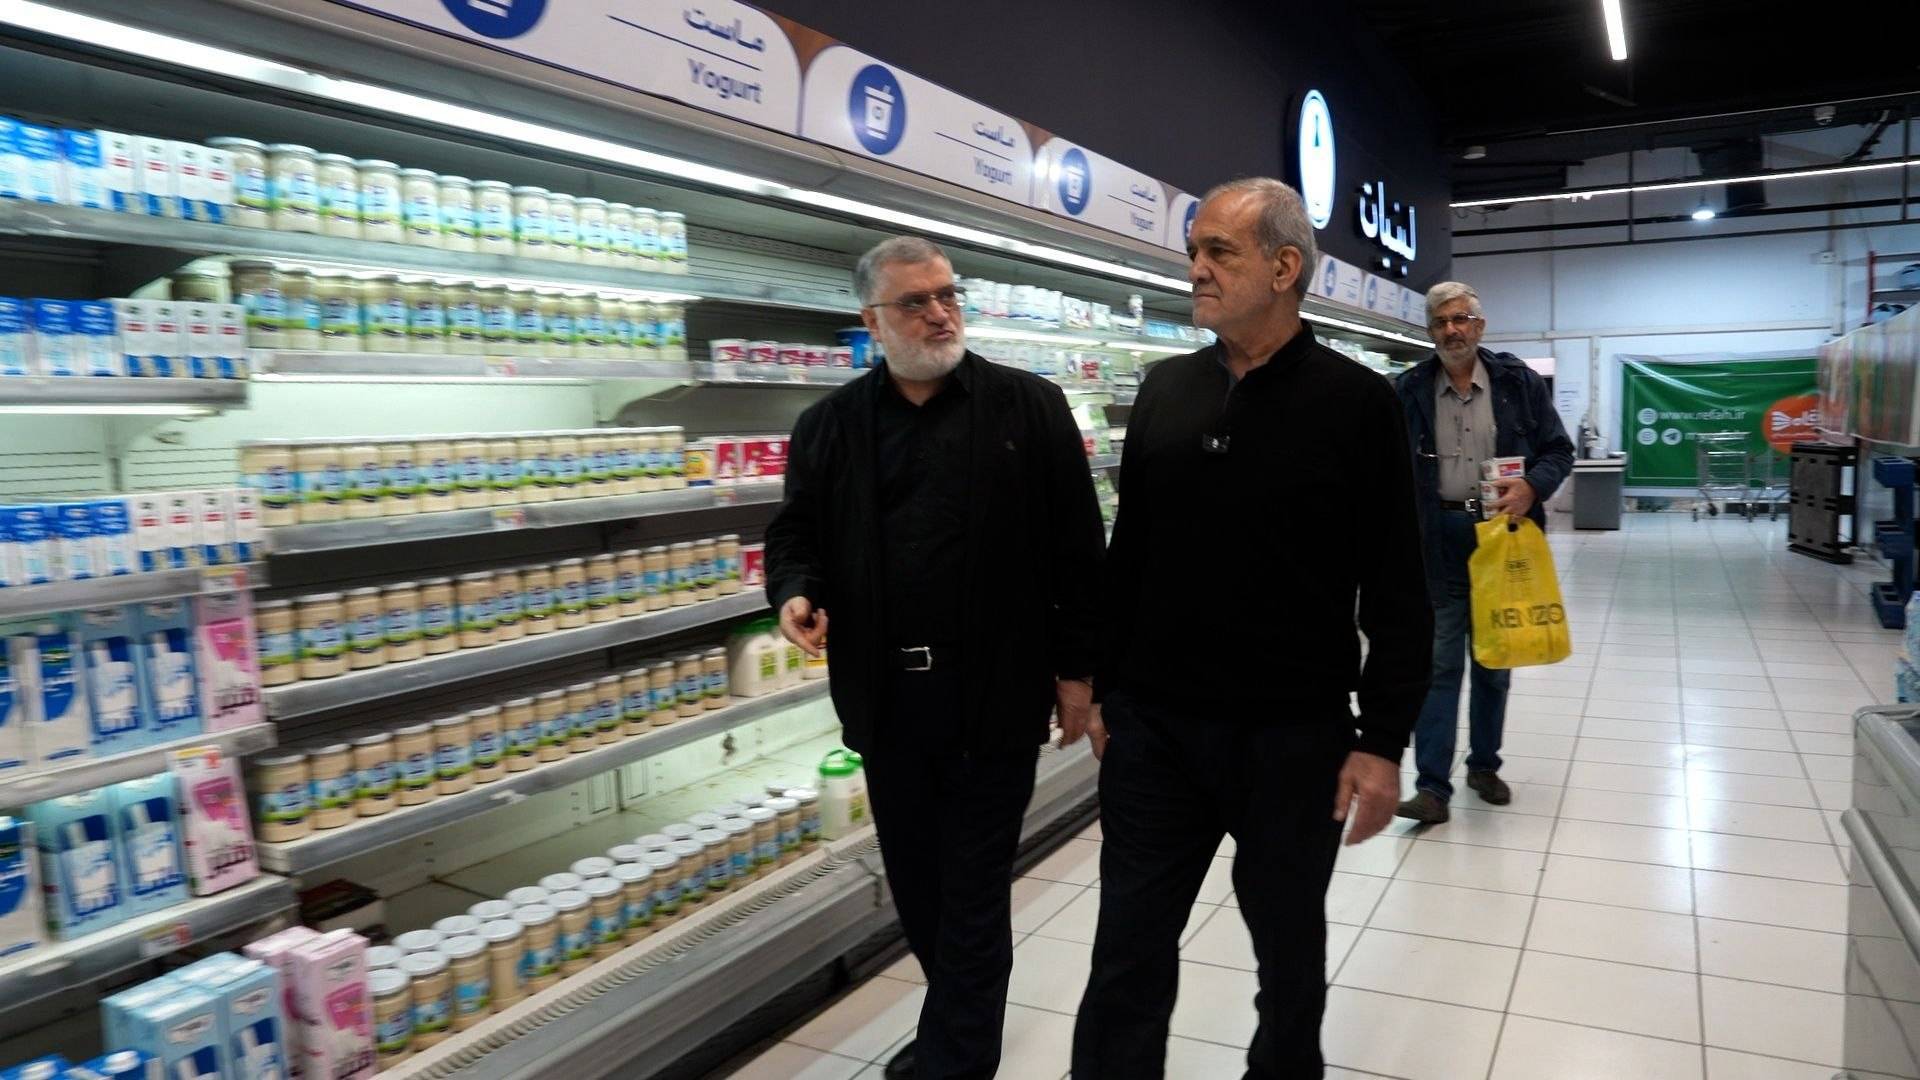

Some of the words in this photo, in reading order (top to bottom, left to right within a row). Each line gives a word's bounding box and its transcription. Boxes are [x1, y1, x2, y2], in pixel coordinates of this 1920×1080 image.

[681, 8, 766, 52] ماست
[688, 58, 762, 104] Yogurt
[972, 121, 1016, 148] ماست
[974, 157, 1013, 185] Yogurt
[1490, 603, 1565, 628] KENZO
